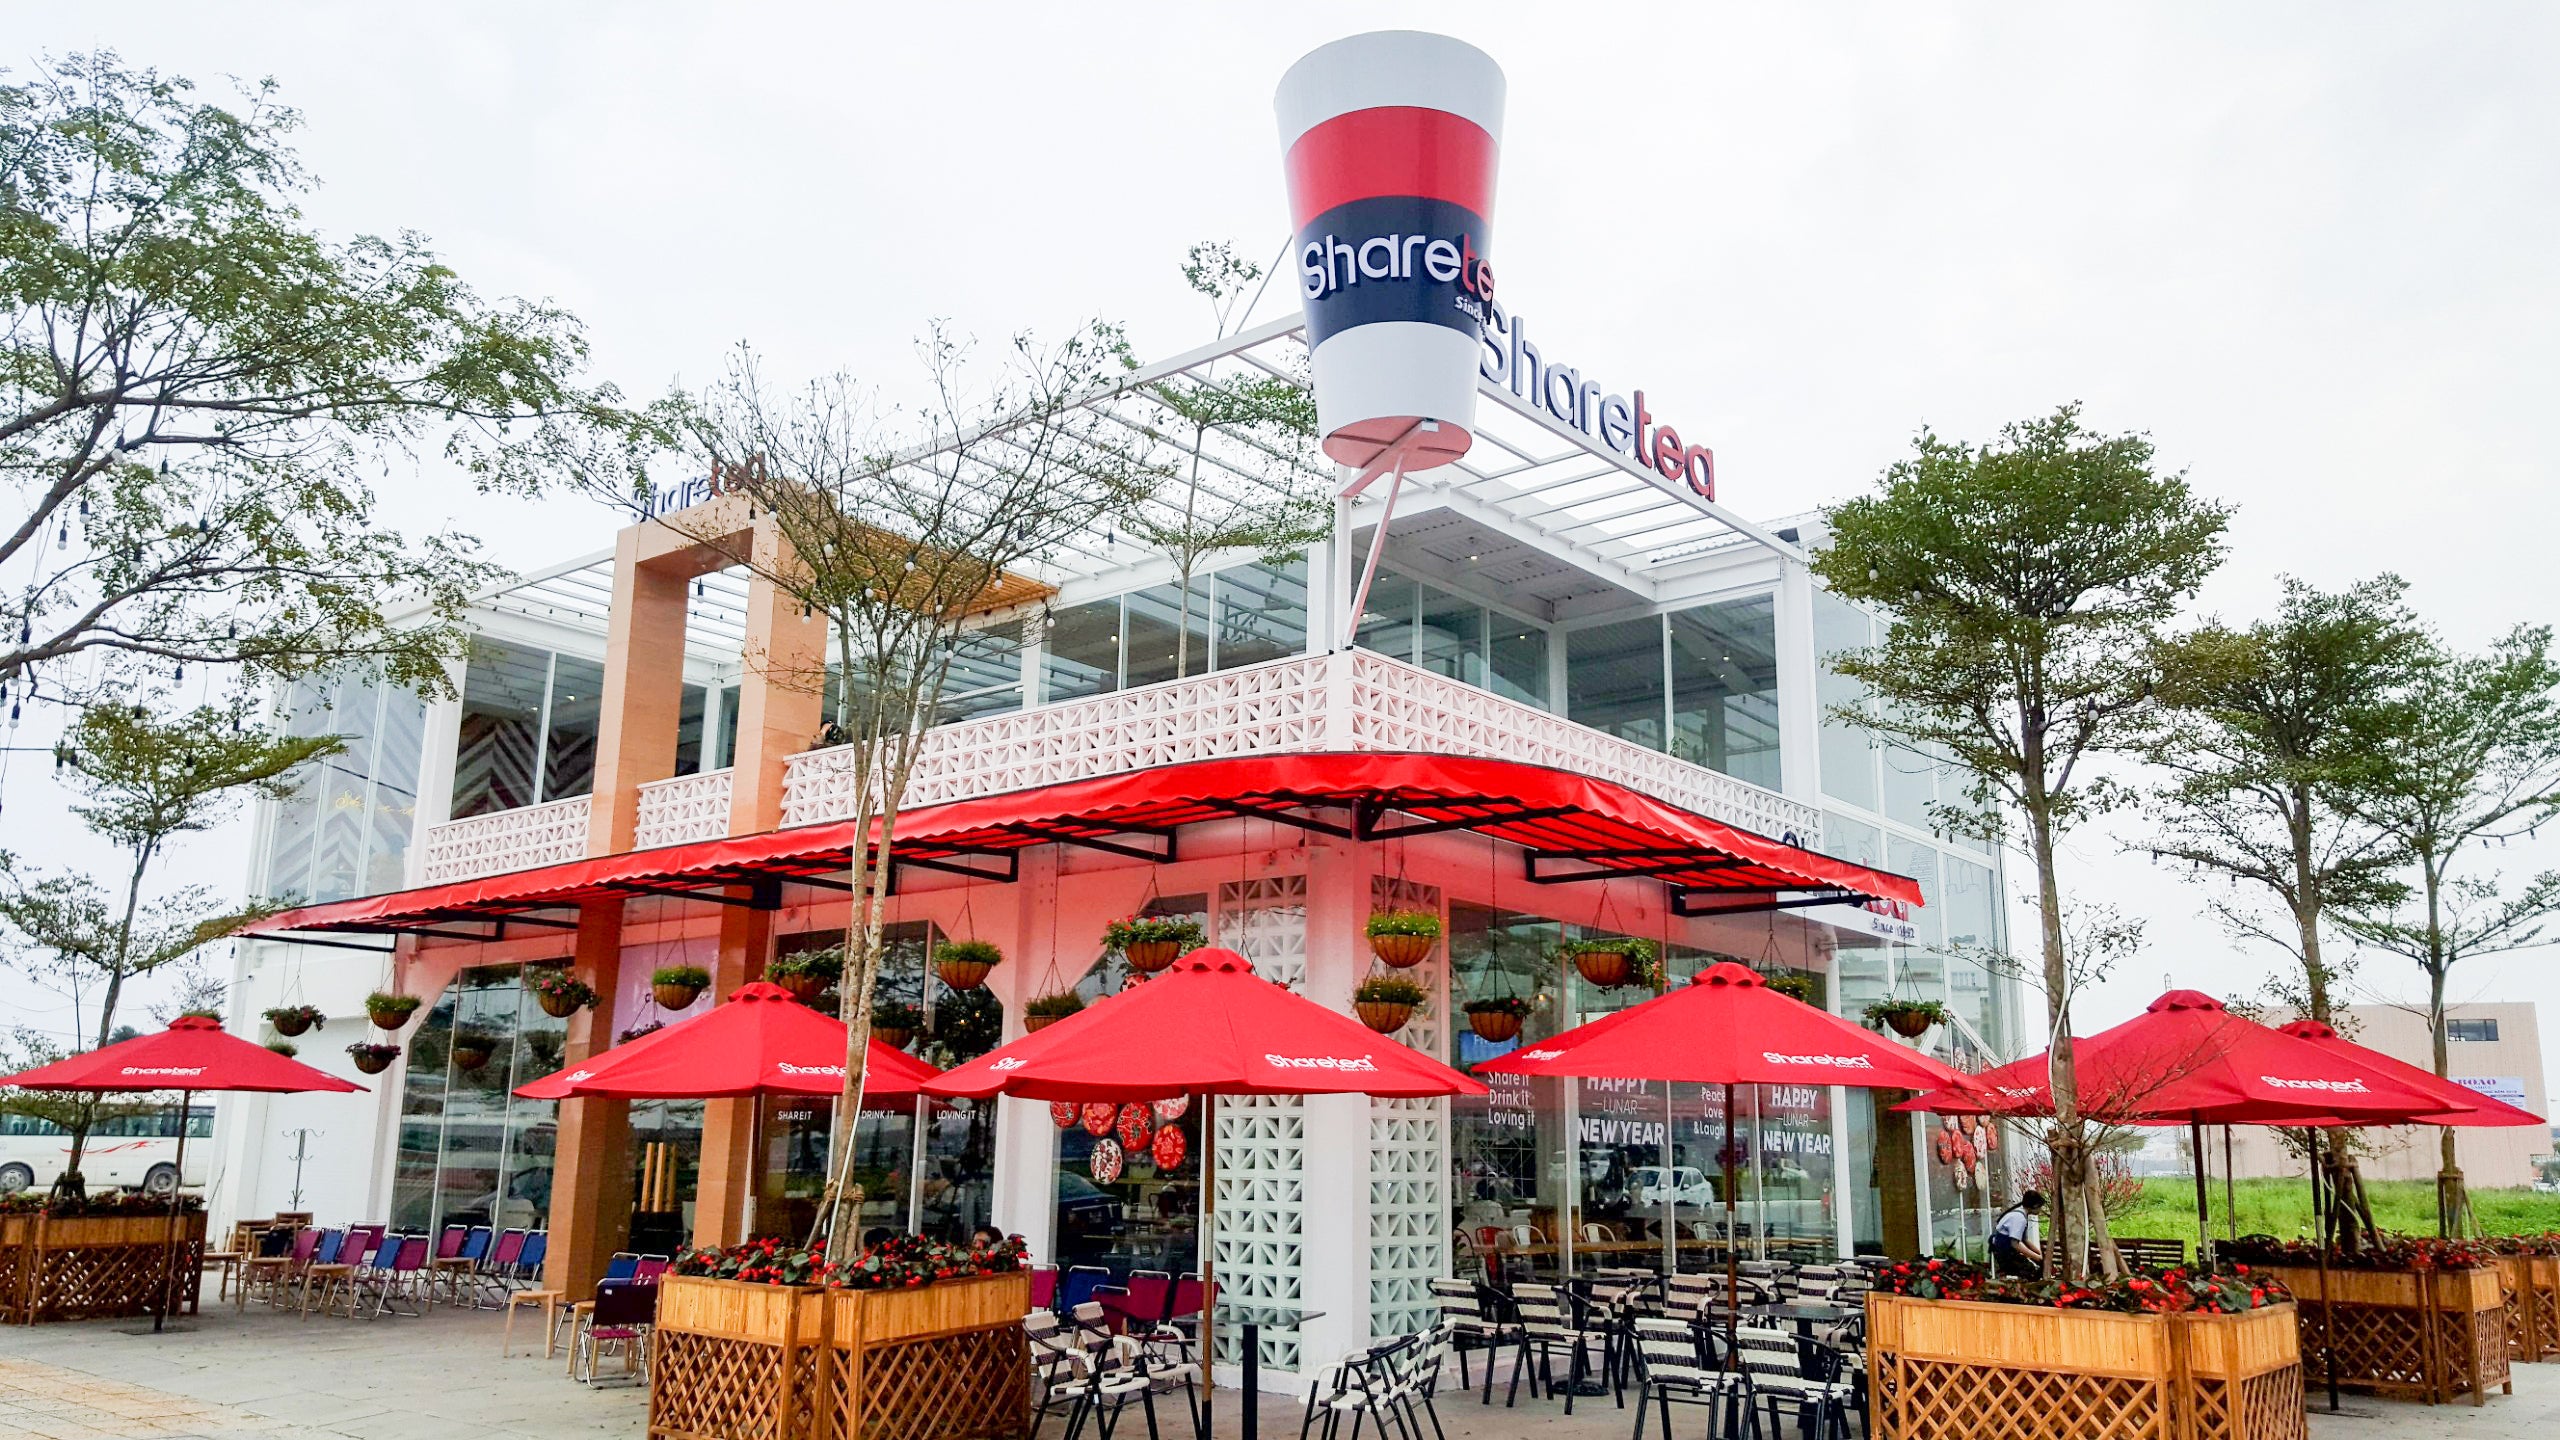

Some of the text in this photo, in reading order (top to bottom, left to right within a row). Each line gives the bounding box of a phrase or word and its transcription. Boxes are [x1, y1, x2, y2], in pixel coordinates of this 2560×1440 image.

[1301, 233, 1494, 303] Sharete
[1479, 298, 1715, 503] Sharetea
[1264, 1054, 1374, 1068] Sharetea
[1763, 1051, 1870, 1066] Sharetea
[121, 1067, 204, 1076] Sharetea
[778, 1062, 870, 1077] Sharet
[1587, 1076, 1648, 1095] HAPPY
[2261, 1075, 2368, 1090] Sharetea
[1489, 1089, 1530, 1106] Drink it
[1701, 1086, 1726, 1102] Peace
[1772, 1086, 1818, 1109] HAPPY
[1603, 1096, 1638, 1115] LUNAR
[1704, 1104, 1724, 1119] Love
[861, 1110, 895, 1120] DRINK IT
[936, 1110, 976, 1120] LOVING IT
[1488, 1108, 1536, 1130] Loving it
[1783, 1112, 1809, 1128] LUNAR
[1577, 1117, 1665, 1146] NEW YEAR
[1764, 1130, 1831, 1154] NEW YEAR
